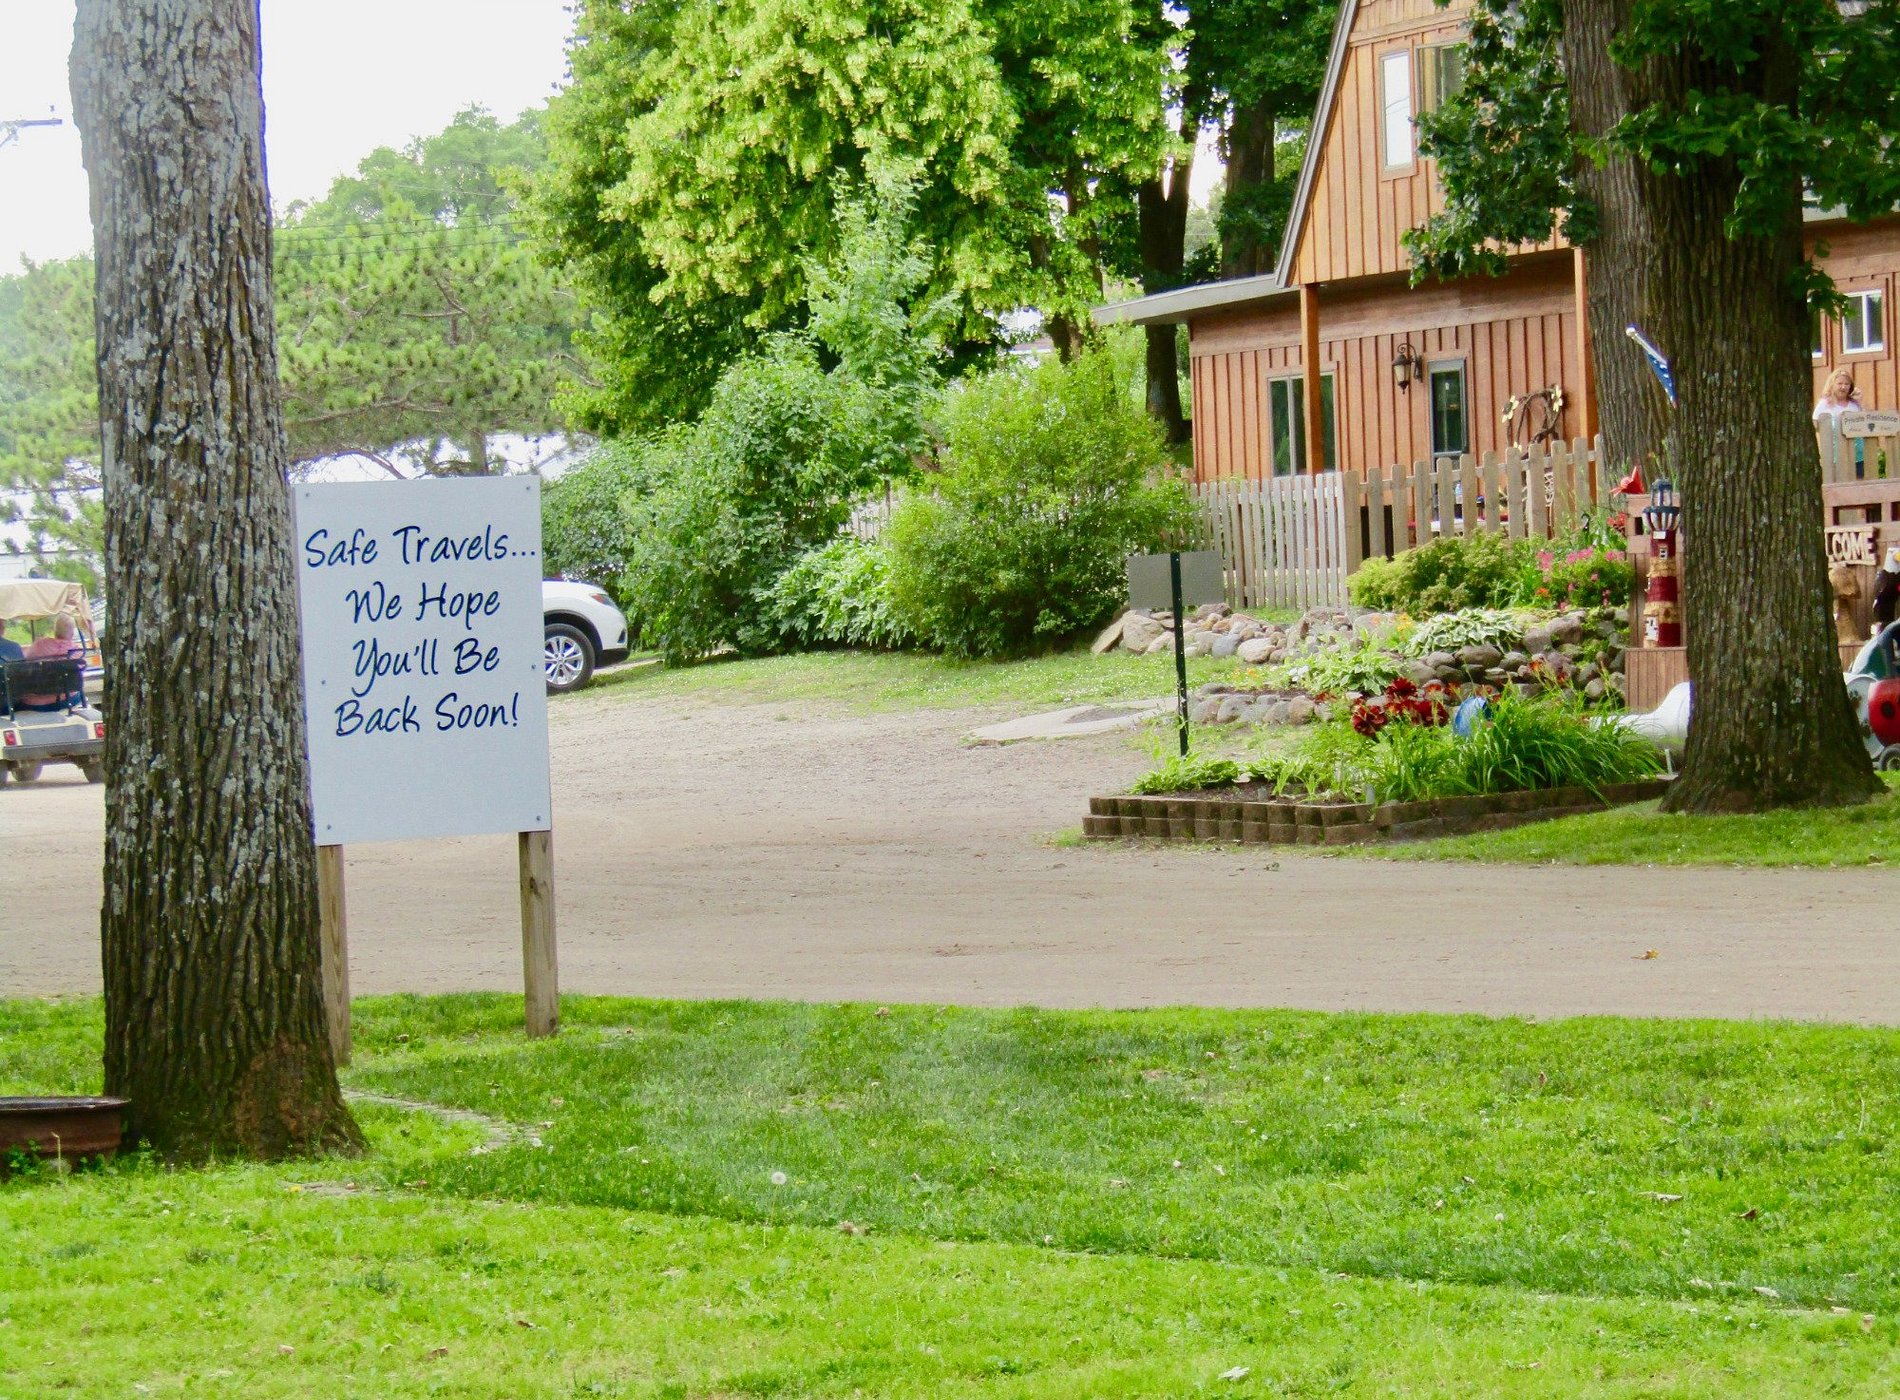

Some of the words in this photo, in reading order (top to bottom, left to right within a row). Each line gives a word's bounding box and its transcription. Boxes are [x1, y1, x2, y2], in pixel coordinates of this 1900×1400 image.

[304, 527, 379, 569] Safe
[1825, 529, 1876, 563] LCOME
[344, 580, 403, 624] We
[415, 581, 501, 631] Hope
[351, 637, 439, 699] You'll
[453, 637, 500, 676] Be
[334, 694, 421, 738] Back
[434, 691, 519, 733] Soon!
